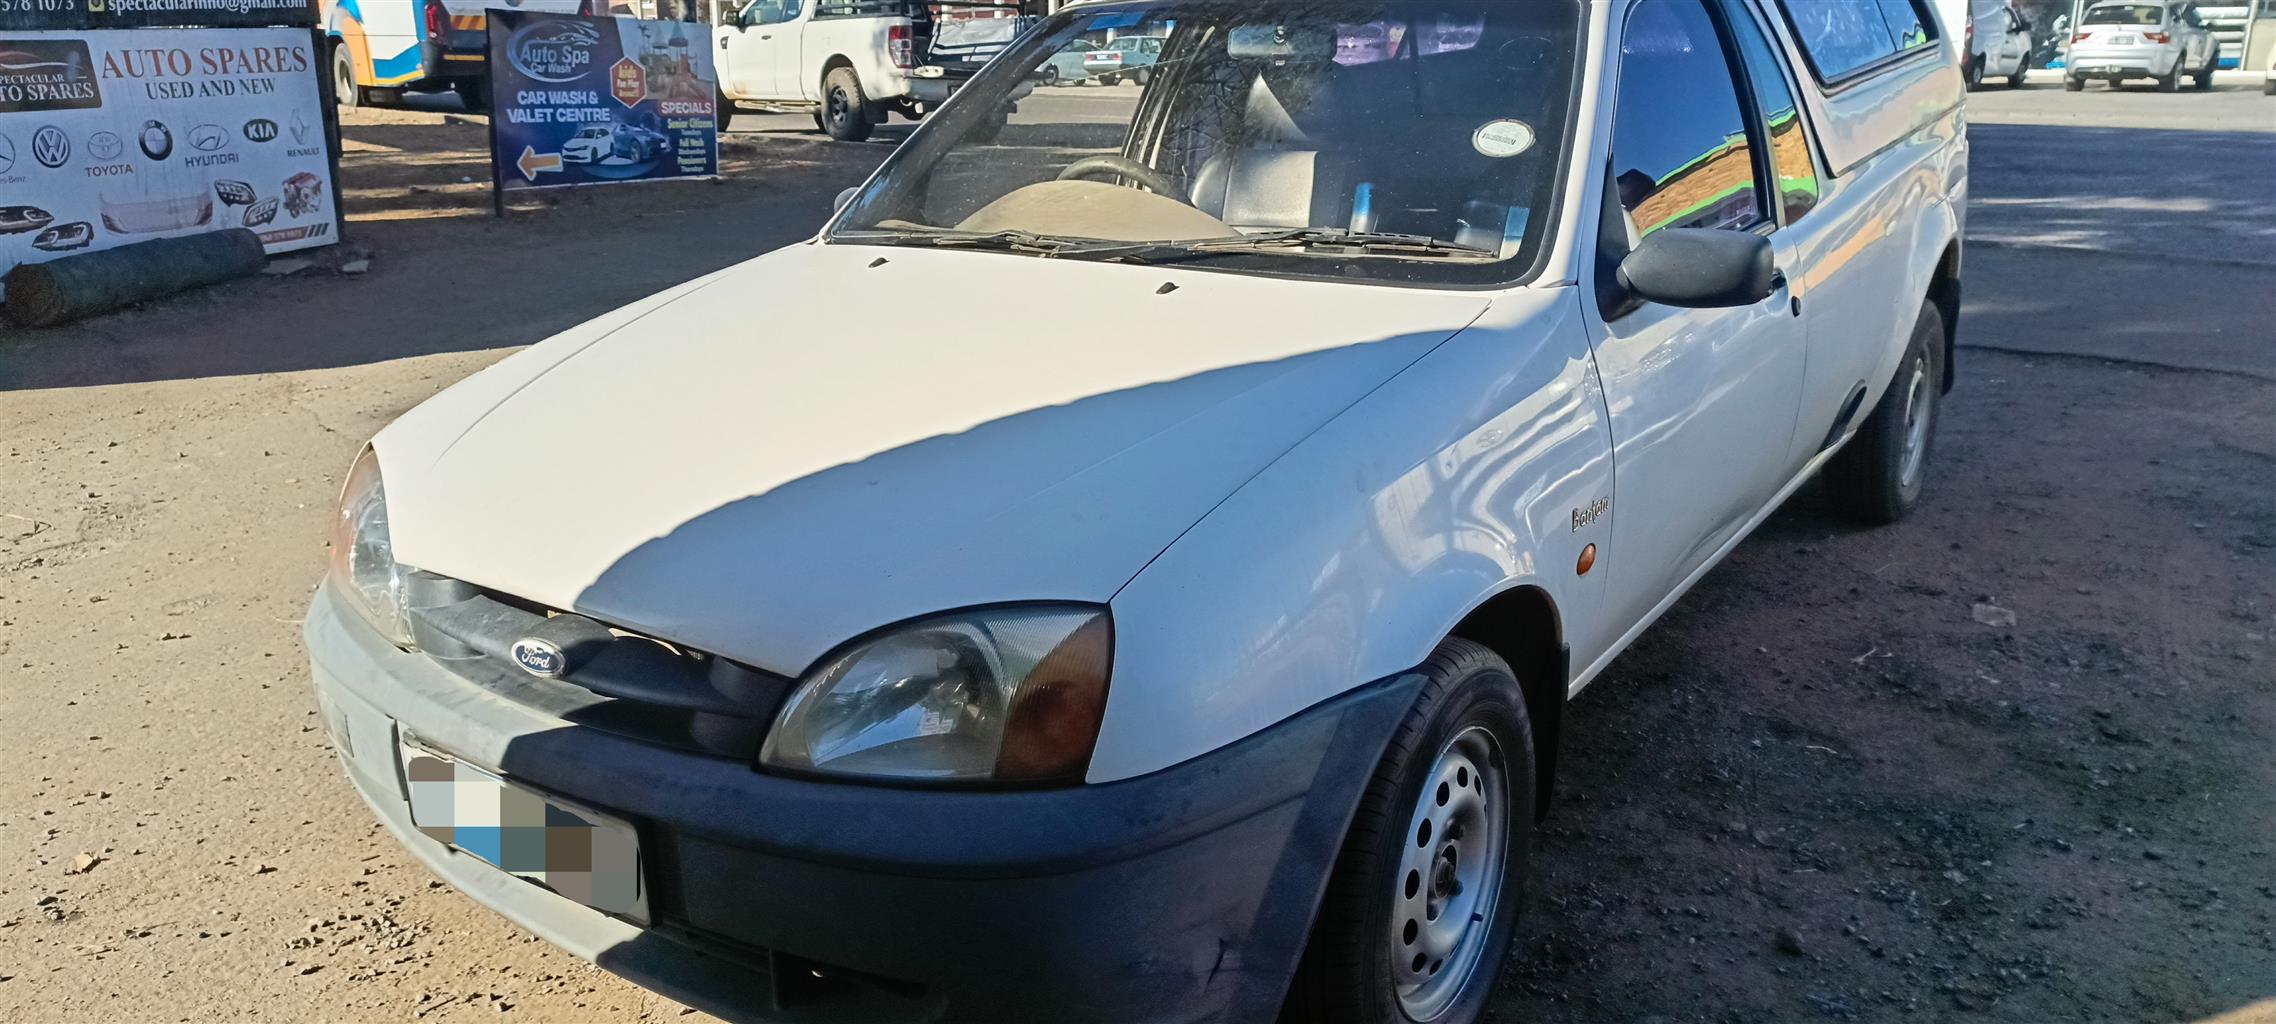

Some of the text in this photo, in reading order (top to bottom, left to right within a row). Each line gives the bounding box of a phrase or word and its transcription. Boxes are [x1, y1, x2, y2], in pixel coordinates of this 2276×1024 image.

[102, 46, 308, 79] AUTO SPARES
[520, 45, 590, 68] Auto Spa
[530, 62, 572, 73] Car Wash
[27, 82, 94, 101] SPARES
[145, 77, 276, 100] USED AND NEW
[517, 90, 599, 105] CAR WASH &
[506, 107, 611, 123] VALET CENTRE
[661, 101, 712, 114] SPECIALS
[248, 125, 275, 138] KIA
[185, 153, 239, 168] HYUNDAI
[85, 164, 133, 177] TOYOTA
[1571, 496, 1609, 533] Bantam
[521, 647, 551, 668] Ford
